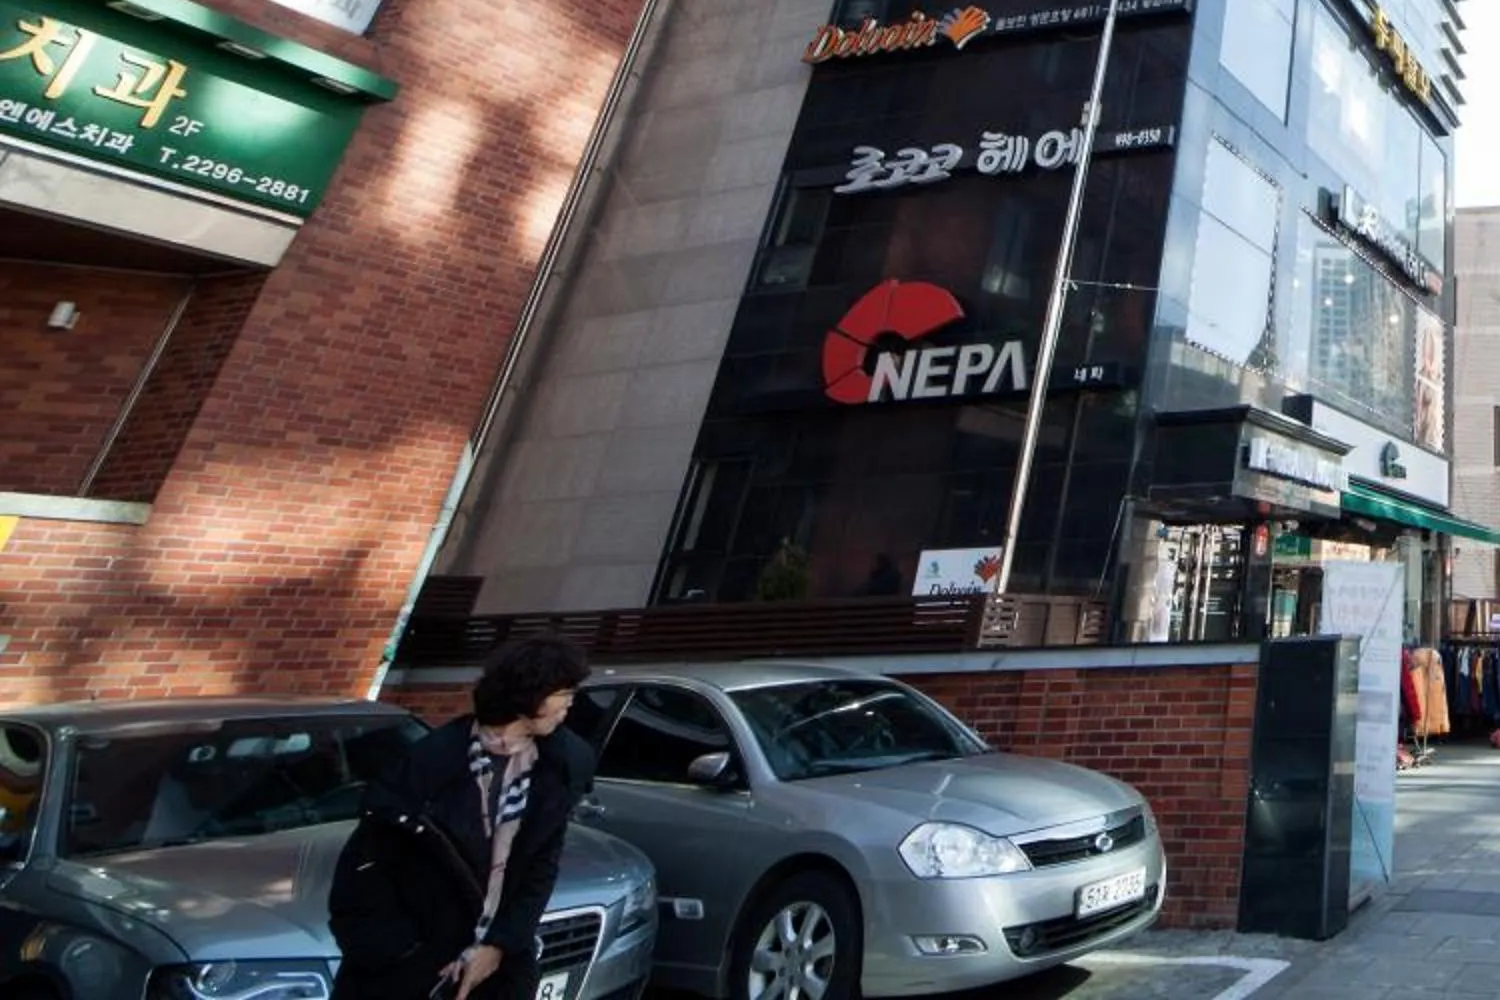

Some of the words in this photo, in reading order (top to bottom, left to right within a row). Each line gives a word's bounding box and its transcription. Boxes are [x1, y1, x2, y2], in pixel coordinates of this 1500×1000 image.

[0, 16, 188, 128] 치과
[169, 115, 205, 138] 2F
[159, 147, 312, 205] T.2296-2881
[833, 143, 964, 194] 로코코
[868, 340, 1028, 403] NEPA
